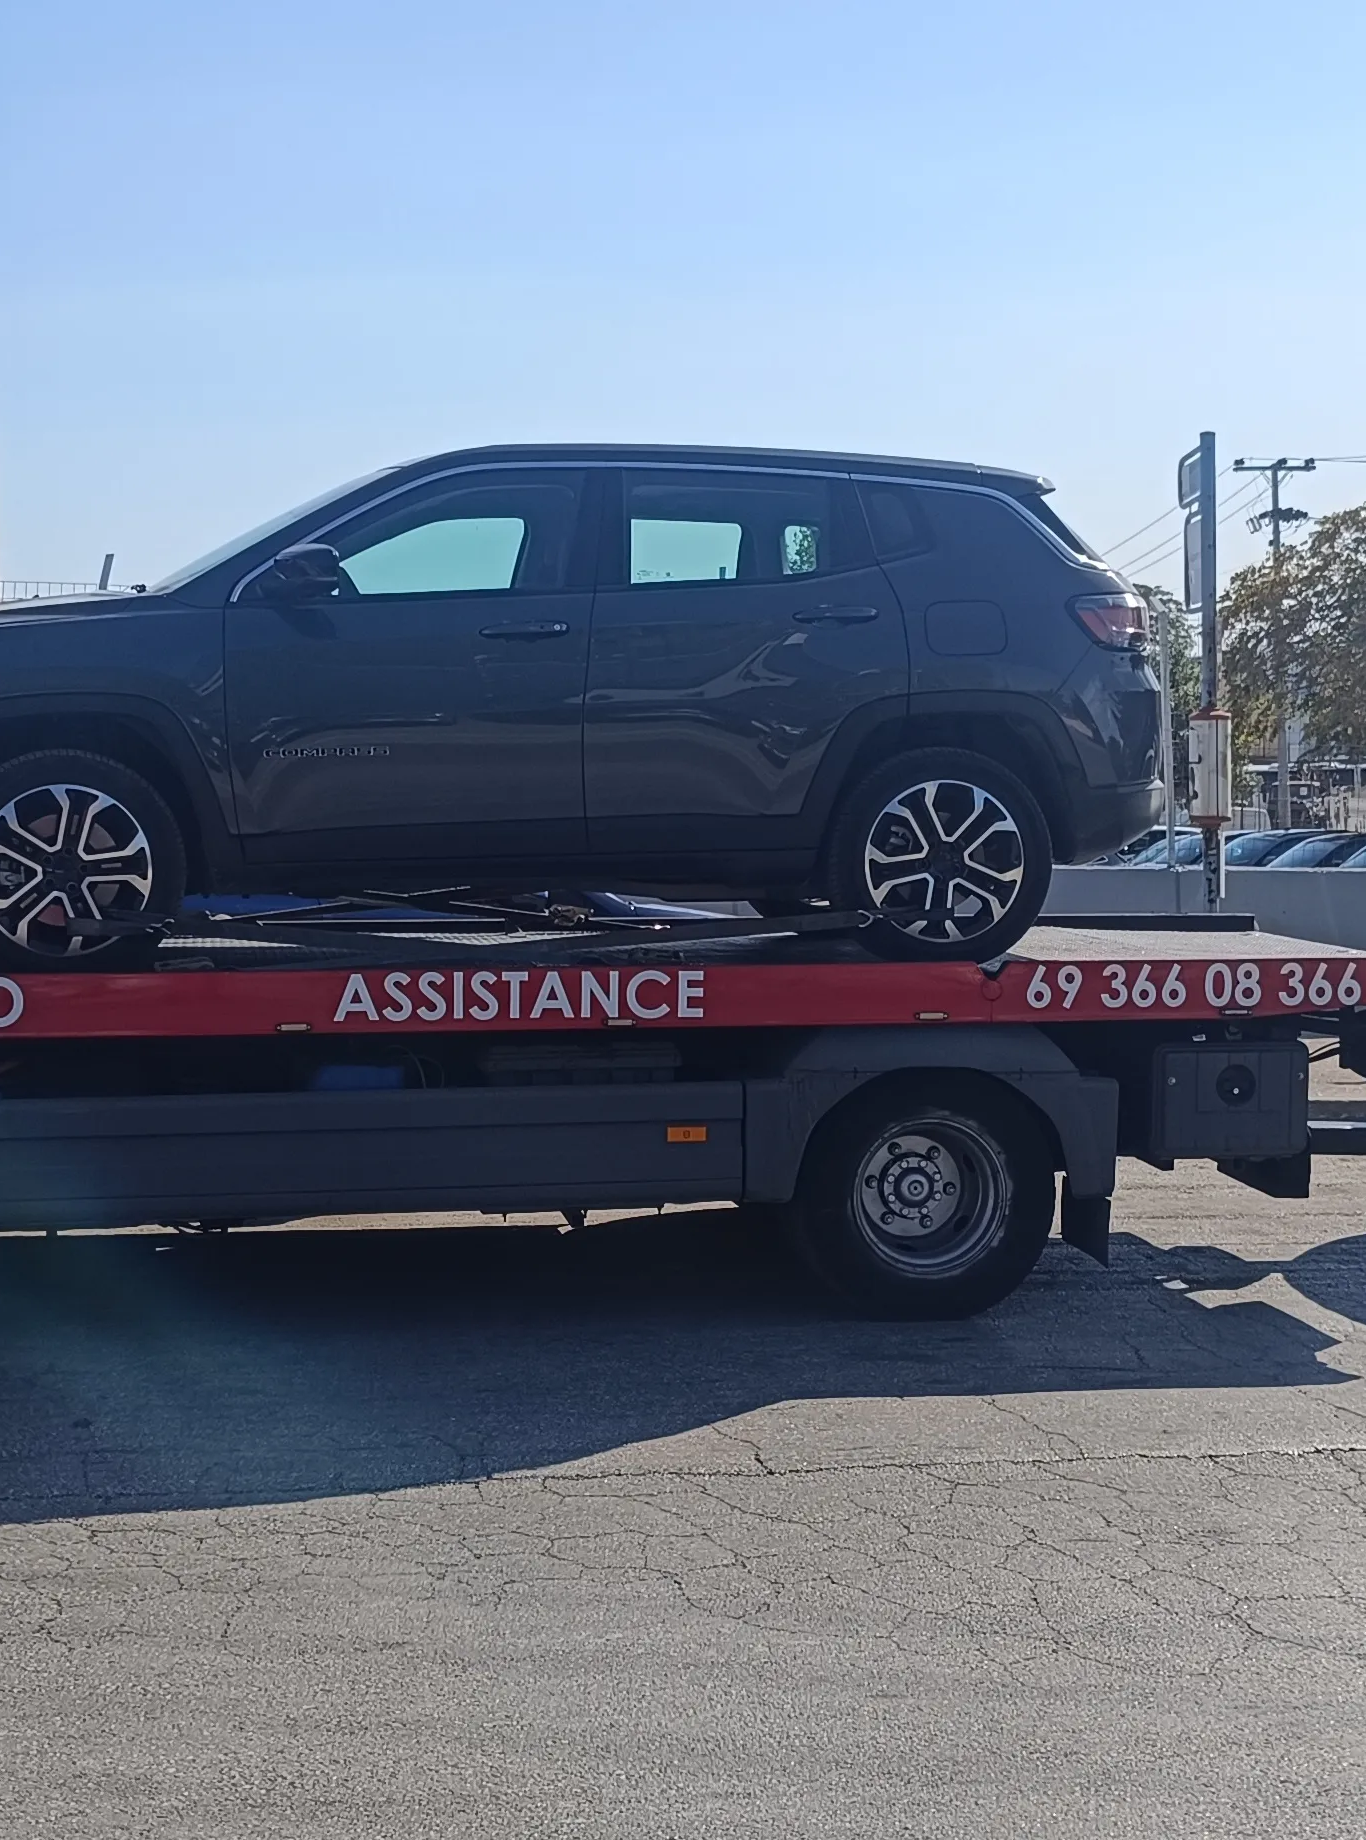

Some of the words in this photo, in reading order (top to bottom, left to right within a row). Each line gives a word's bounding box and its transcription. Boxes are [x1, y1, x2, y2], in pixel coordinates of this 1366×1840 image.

[333, 969, 705, 1021] ASSISTANCE
[1026, 964, 1083, 1009] 69
[1100, 963, 1186, 1008] 366
[1204, 962, 1262, 1007] 08
[1278, 961, 1362, 1006] 366
